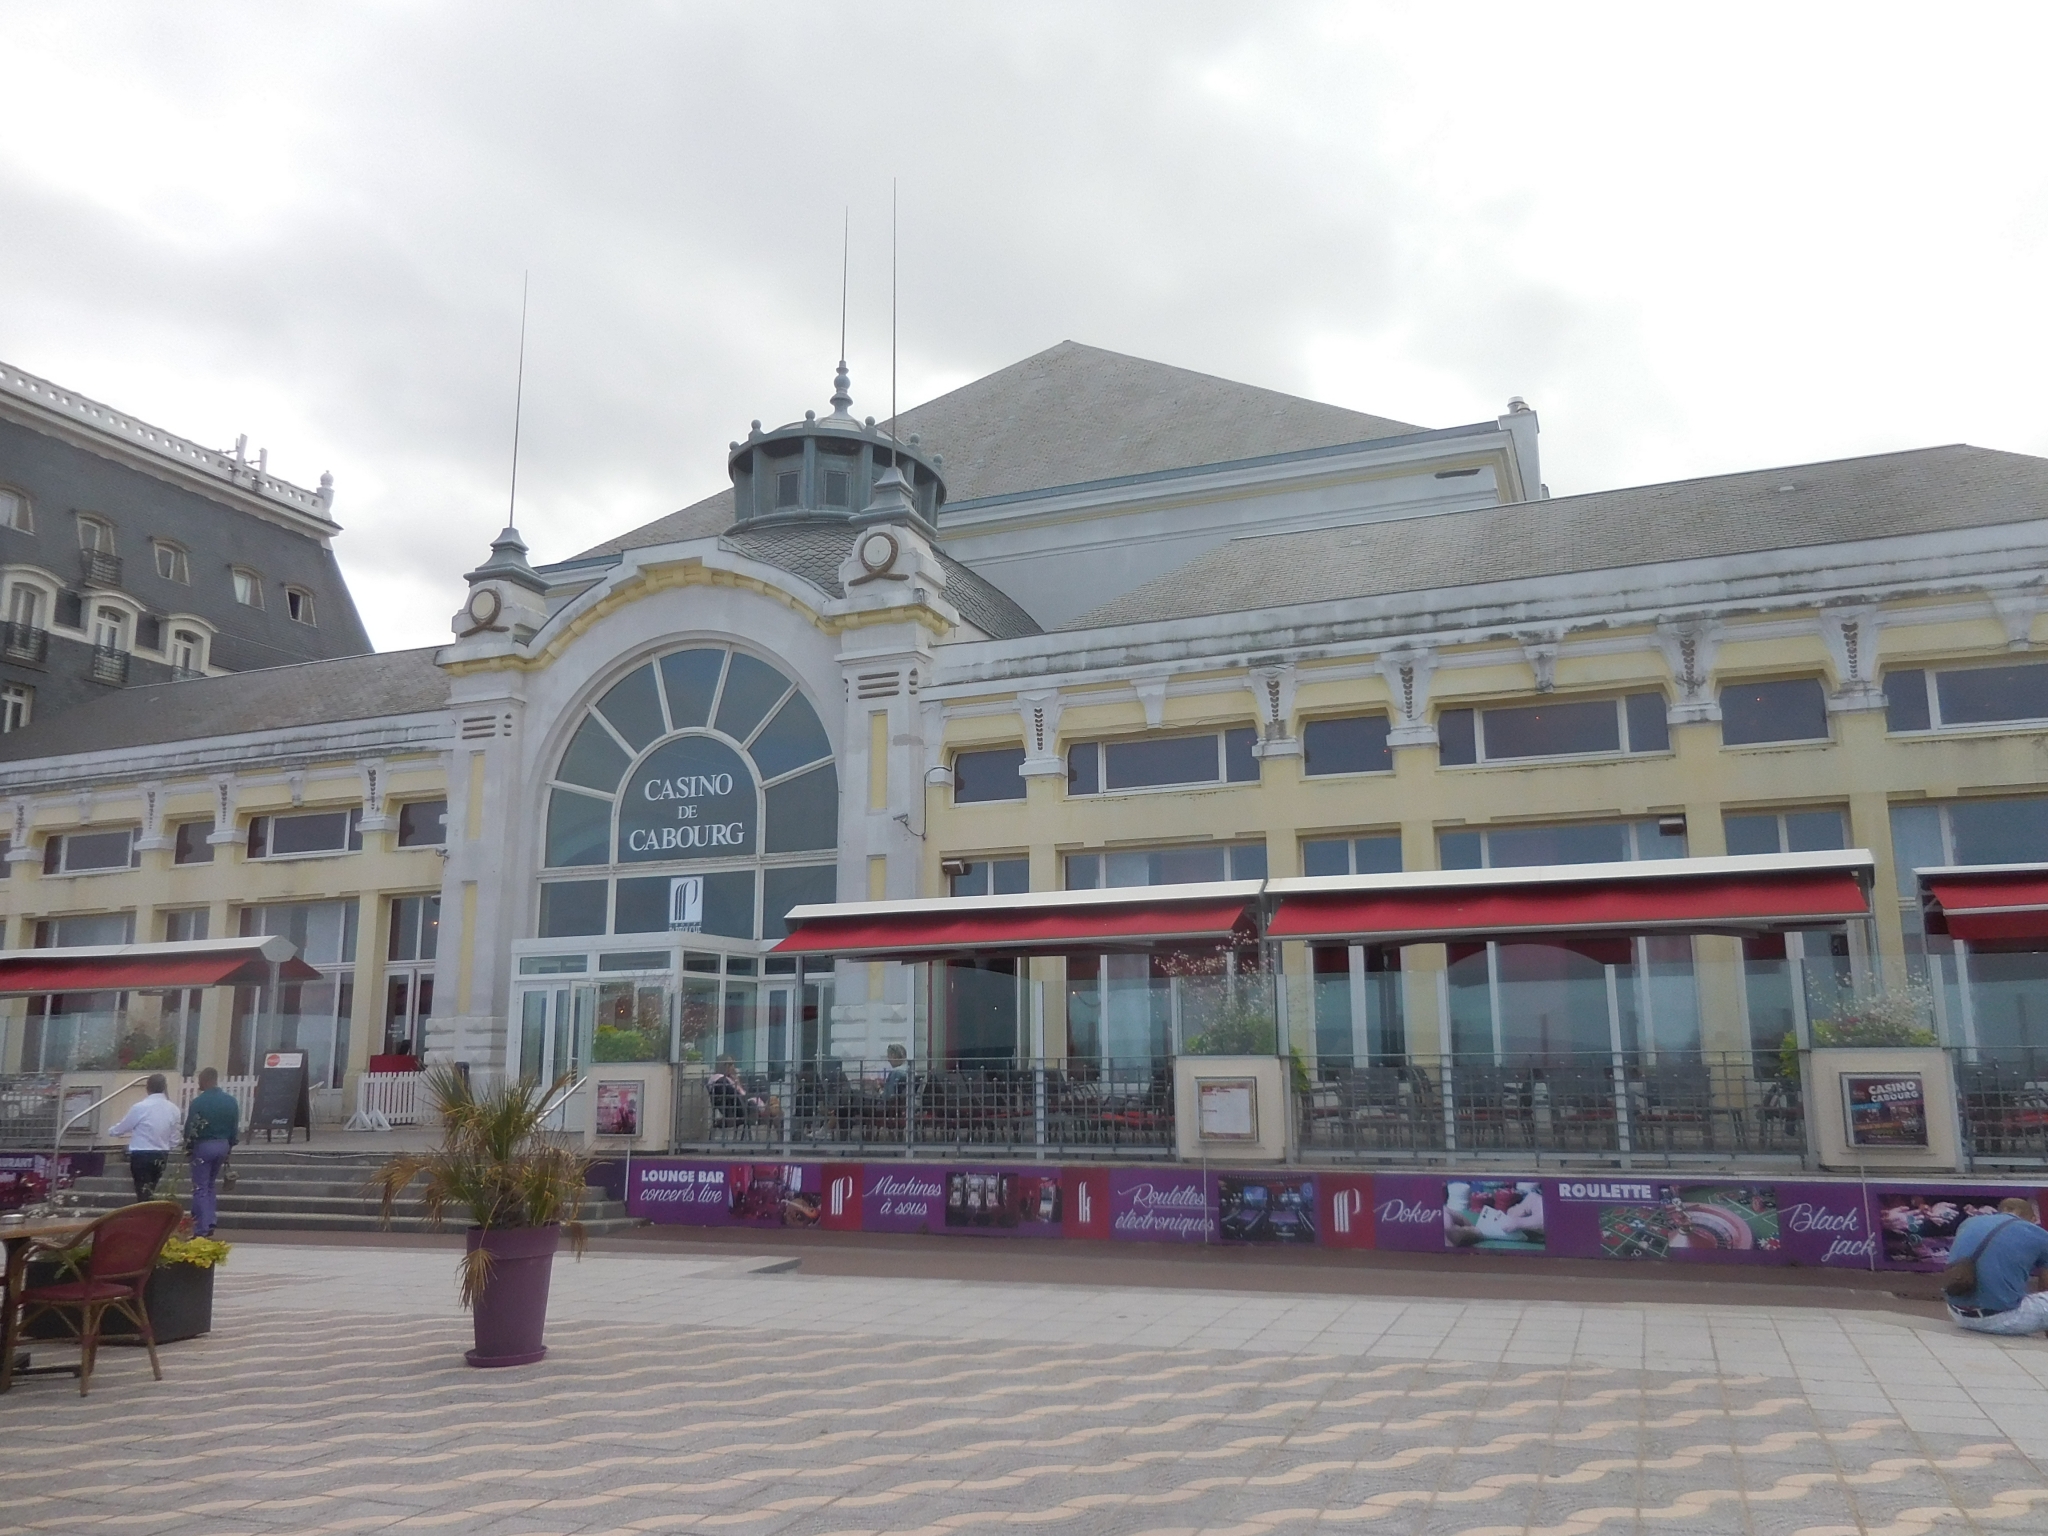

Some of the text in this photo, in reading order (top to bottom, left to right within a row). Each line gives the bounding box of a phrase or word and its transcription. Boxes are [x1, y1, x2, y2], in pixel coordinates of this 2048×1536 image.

[644, 773, 733, 801] CASINO
[677, 805, 698, 820] DE
[629, 822, 745, 851] CABOURG
[1868, 1081, 1917, 1095] CASINO
[1871, 1091, 1919, 1103] CABOURG
[641, 1169, 725, 1183] LOUNGE BAR
[862, 1174, 943, 1198] Machines
[640, 1183, 723, 1203] concerts live
[1117, 1183, 1208, 1209] Roulettes
[1559, 1183, 1652, 1199] ROULETTE
[880, 1198, 928, 1216] à sous
[1374, 1199, 1442, 1223] Poker
[1780, 1203, 1859, 1232] Black
[1821, 1232, 1877, 1262] jack
